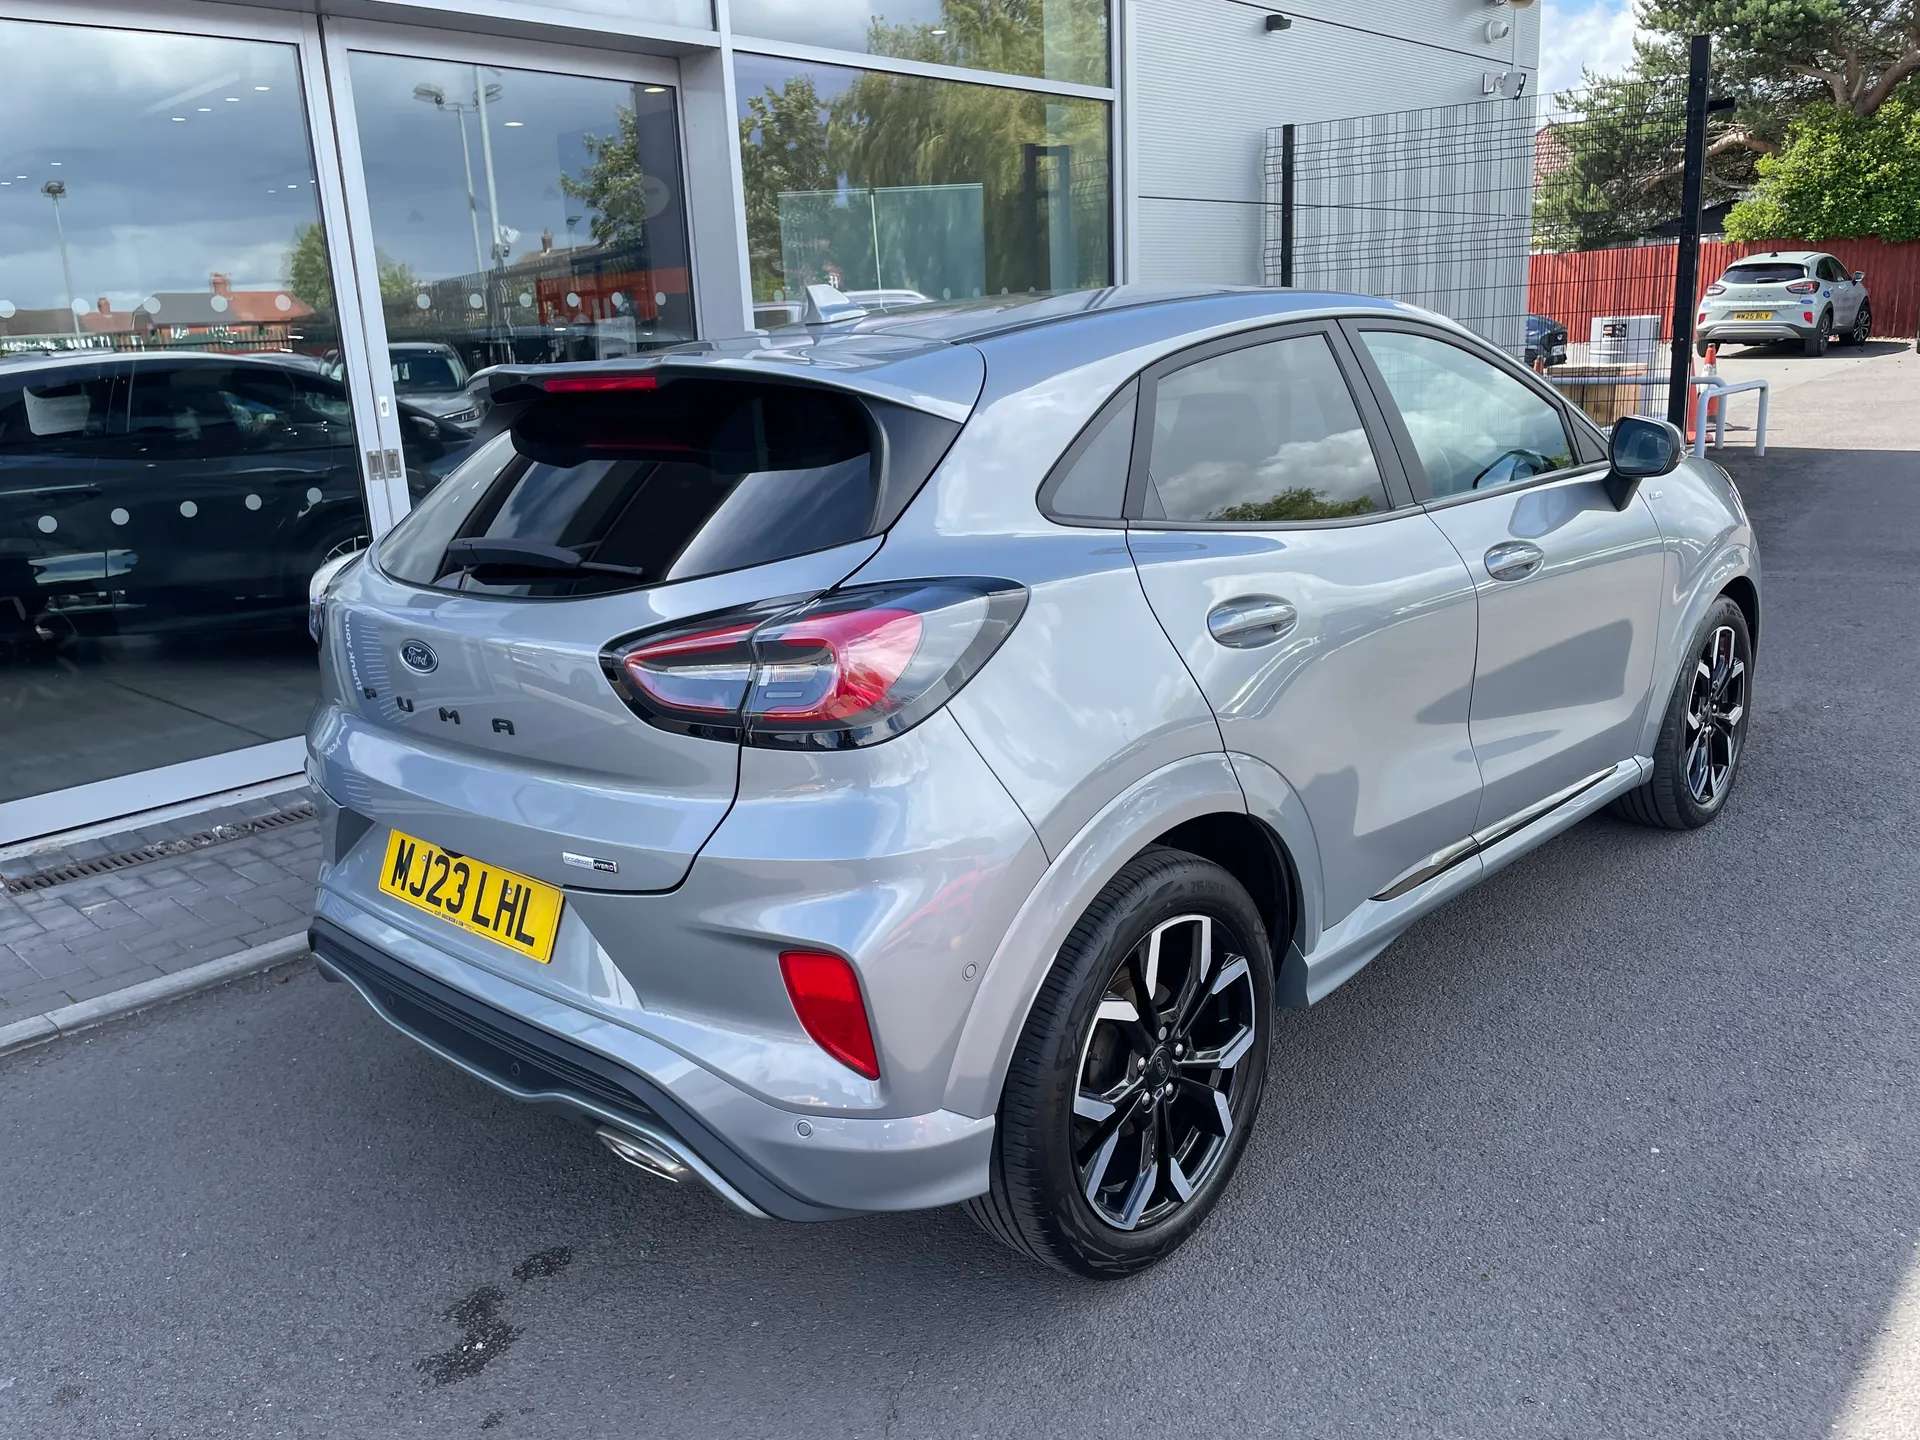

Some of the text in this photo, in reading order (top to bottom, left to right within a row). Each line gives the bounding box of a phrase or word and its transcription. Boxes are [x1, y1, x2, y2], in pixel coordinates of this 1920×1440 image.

[363, 687, 515, 736] PUMA
[390, 838, 535, 947] MJ23 LHL
